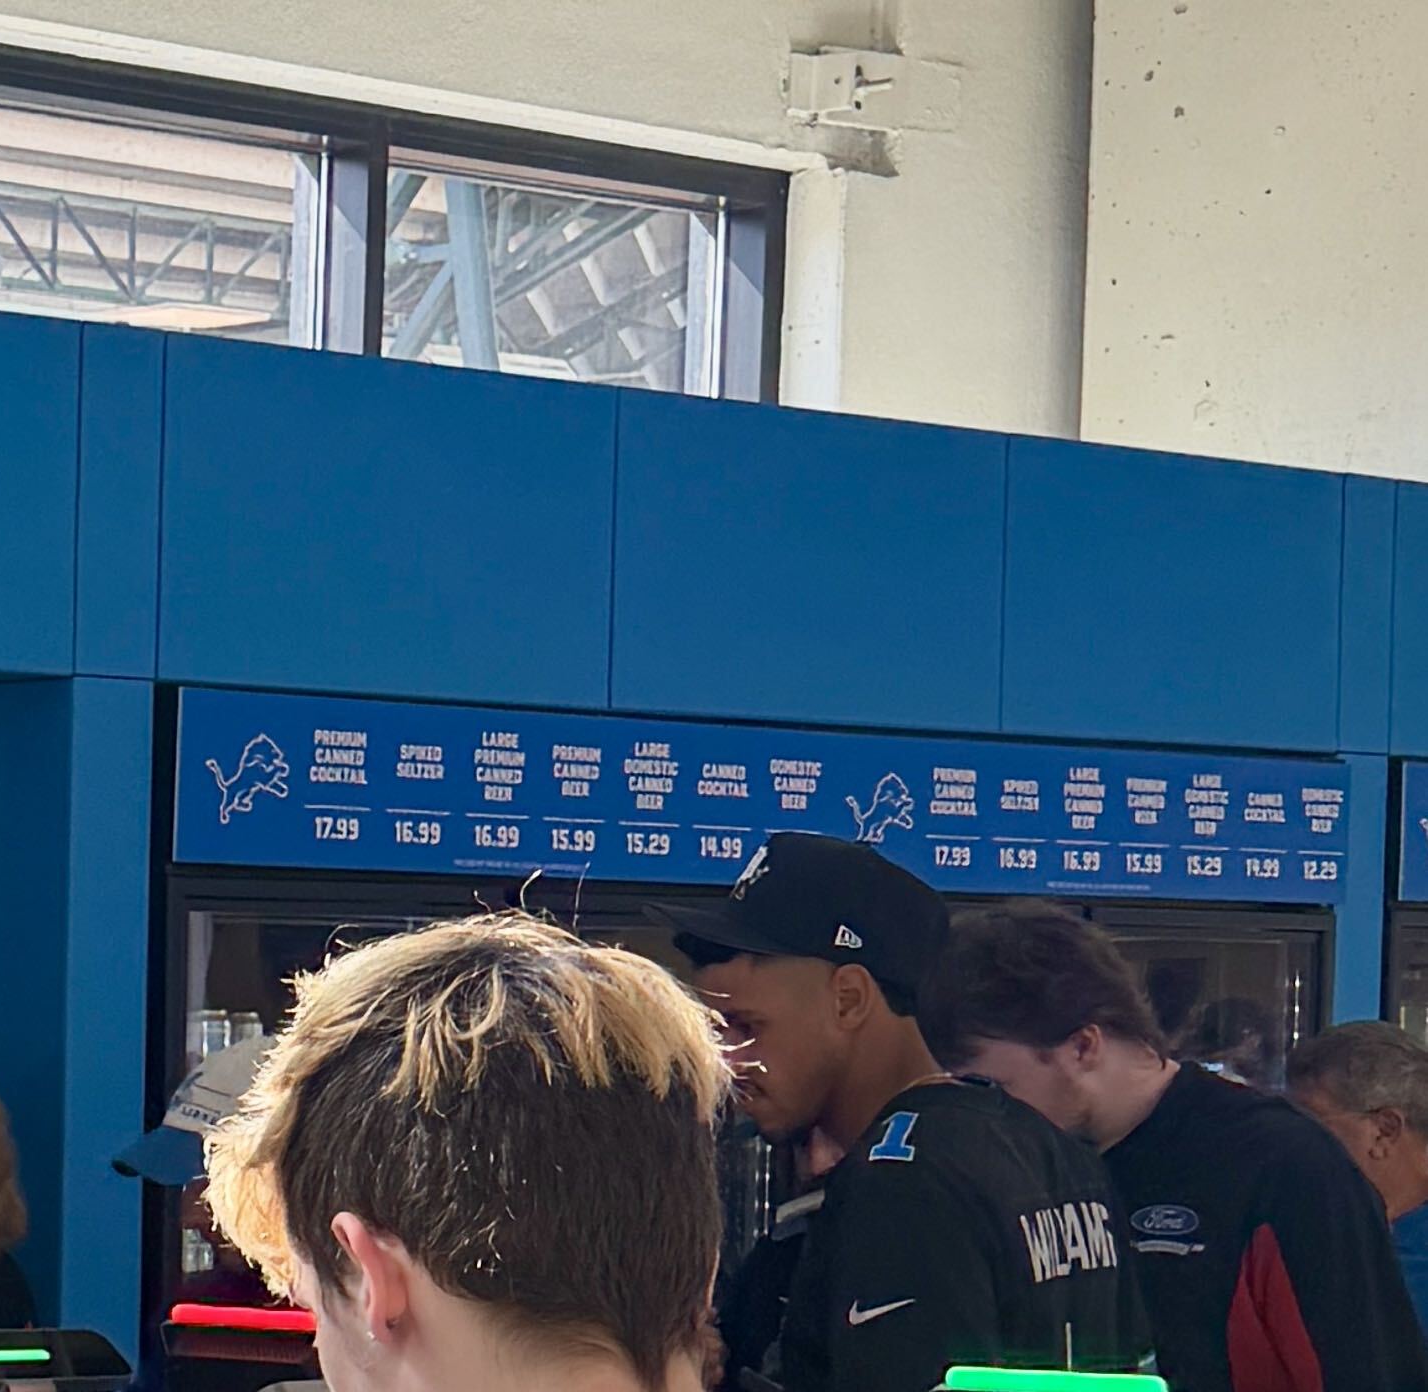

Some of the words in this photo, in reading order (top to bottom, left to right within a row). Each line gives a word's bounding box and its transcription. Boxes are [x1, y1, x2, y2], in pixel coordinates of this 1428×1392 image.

[314, 729, 367, 748] PREMIUM
[482, 731, 519, 748] LARGE
[315, 748, 365, 766] CANNED
[400, 744, 442, 762] SPIKED
[474, 748, 525, 767] PREMIUM
[552, 744, 601, 763] PREMIUM
[635, 741, 670, 758] LARGE
[310, 766, 368, 785] COCKTAIL
[397, 762, 444, 779] SELTZER
[476, 767, 523, 784] CANNED
[553, 762, 600, 780] CANNED
[624, 758, 678, 776] DOMESTIC
[702, 763, 746, 780] CANNED
[769, 758, 822, 777] DOMESTIC
[484, 784, 513, 801] BEER
[561, 780, 590, 797] BEER
[628, 776, 673, 793] CANNED
[697, 780, 749, 798] COCKTAIL
[774, 776, 817, 793] CANNED
[636, 794, 664, 810] BEER
[781, 794, 807, 810] BEER
[315, 816, 359, 841] 17.99
[395, 820, 441, 845] 16.99
[475, 825, 520, 848] 16.99
[551, 828, 595, 851] 15.99
[626, 832, 670, 856] 15.29
[700, 836, 742, 858] 14.99
[935, 845, 971, 867] 17.99
[1063, 850, 1101, 872] 16.99
[1125, 853, 1162, 874] 15.99
[1186, 855, 1222, 877] 15.29
[1303, 860, 1338, 880] 12.29
[869, 1110, 920, 1162] 1
